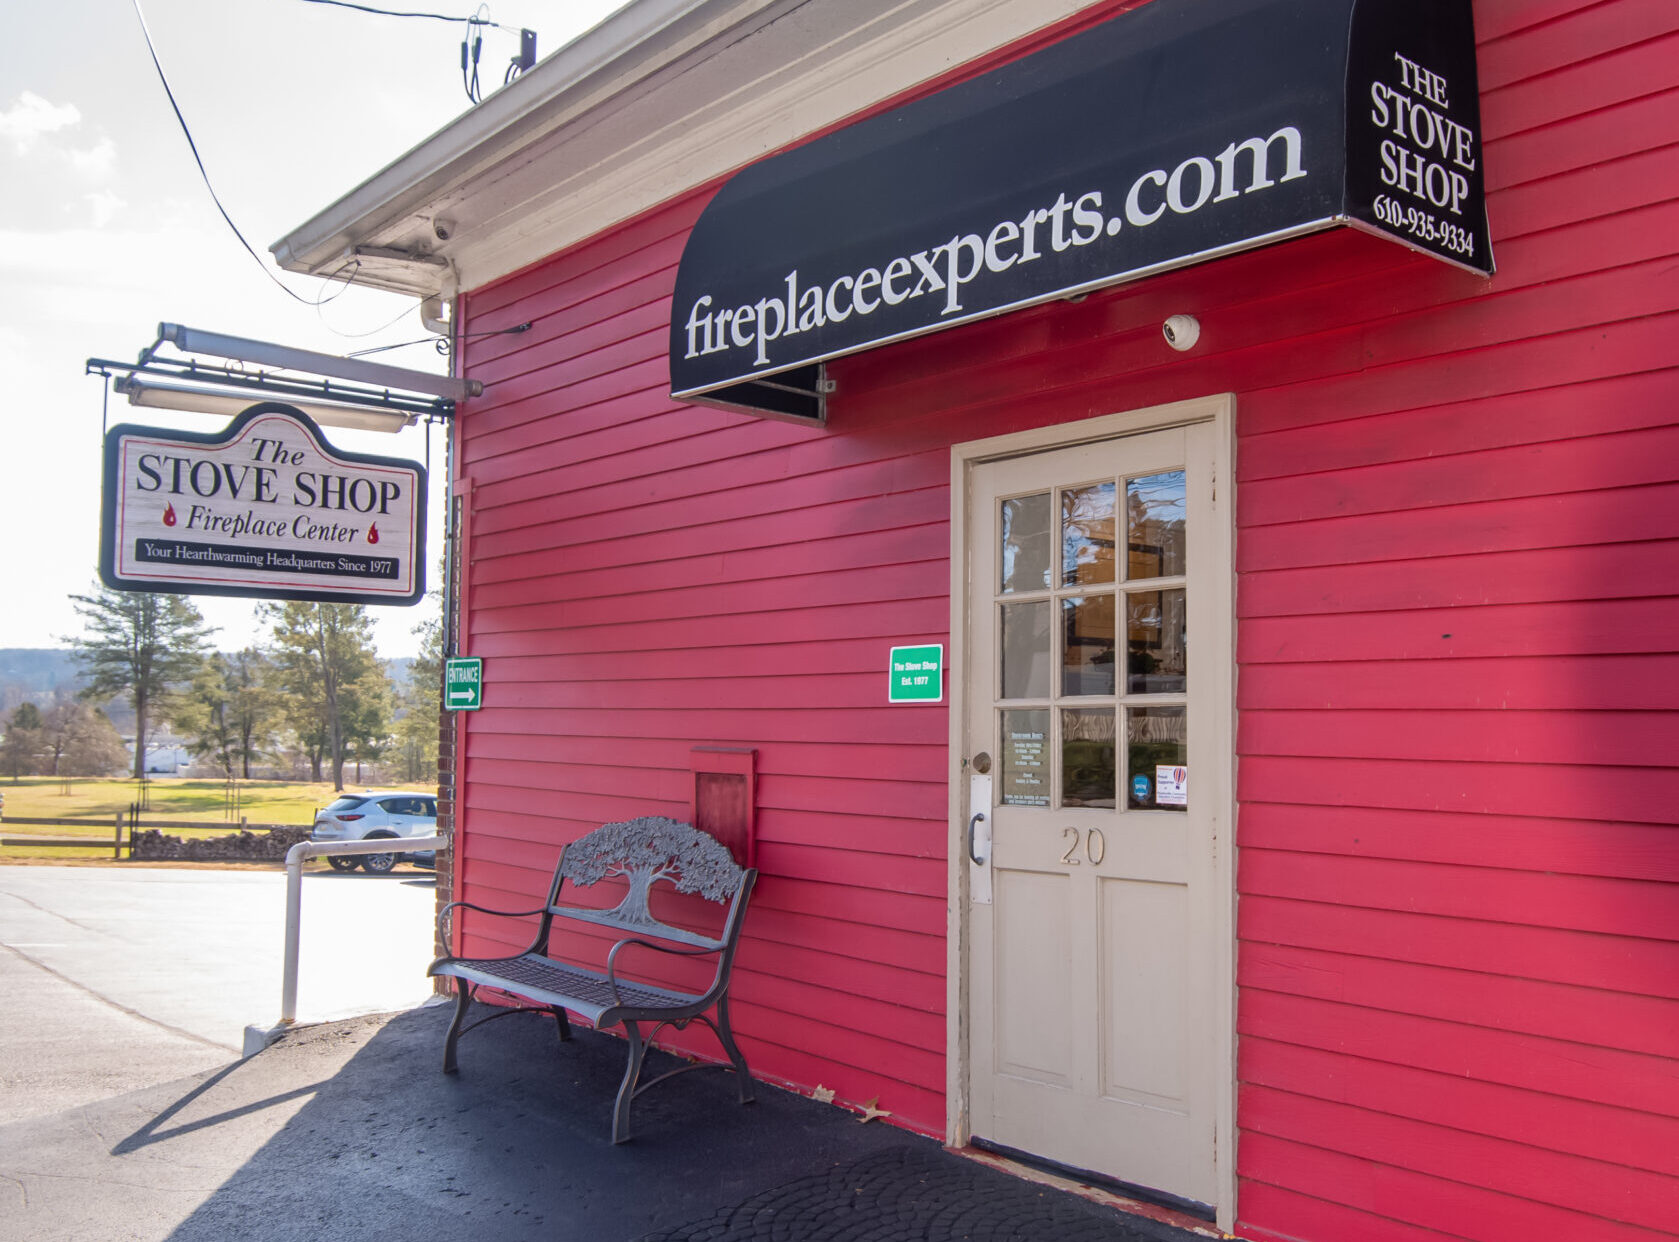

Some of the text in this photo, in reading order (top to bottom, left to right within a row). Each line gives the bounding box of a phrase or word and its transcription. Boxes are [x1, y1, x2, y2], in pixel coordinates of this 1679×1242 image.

[1395, 51, 1448, 109] THE
[1371, 81, 1475, 171] STOVE
[1380, 139, 1469, 215] SHOP
[1373, 194, 1474, 257] 610-935-9334
[684, 126, 1307, 366] fireplaceexperts.com
[251, 437, 304, 466] The
[136, 454, 401, 514] STOVE SHOP
[185, 504, 359, 542] Fireplace Center
[145, 543, 392, 574] Your Hearthwarming Headquarters Since 1977
[449, 666, 478, 683] ENTRANCE
[894, 663, 905, 671] The
[922, 661, 938, 671] Shop
[901, 676, 928, 685] Est. 1977
[1060, 826, 1105, 866] 20
